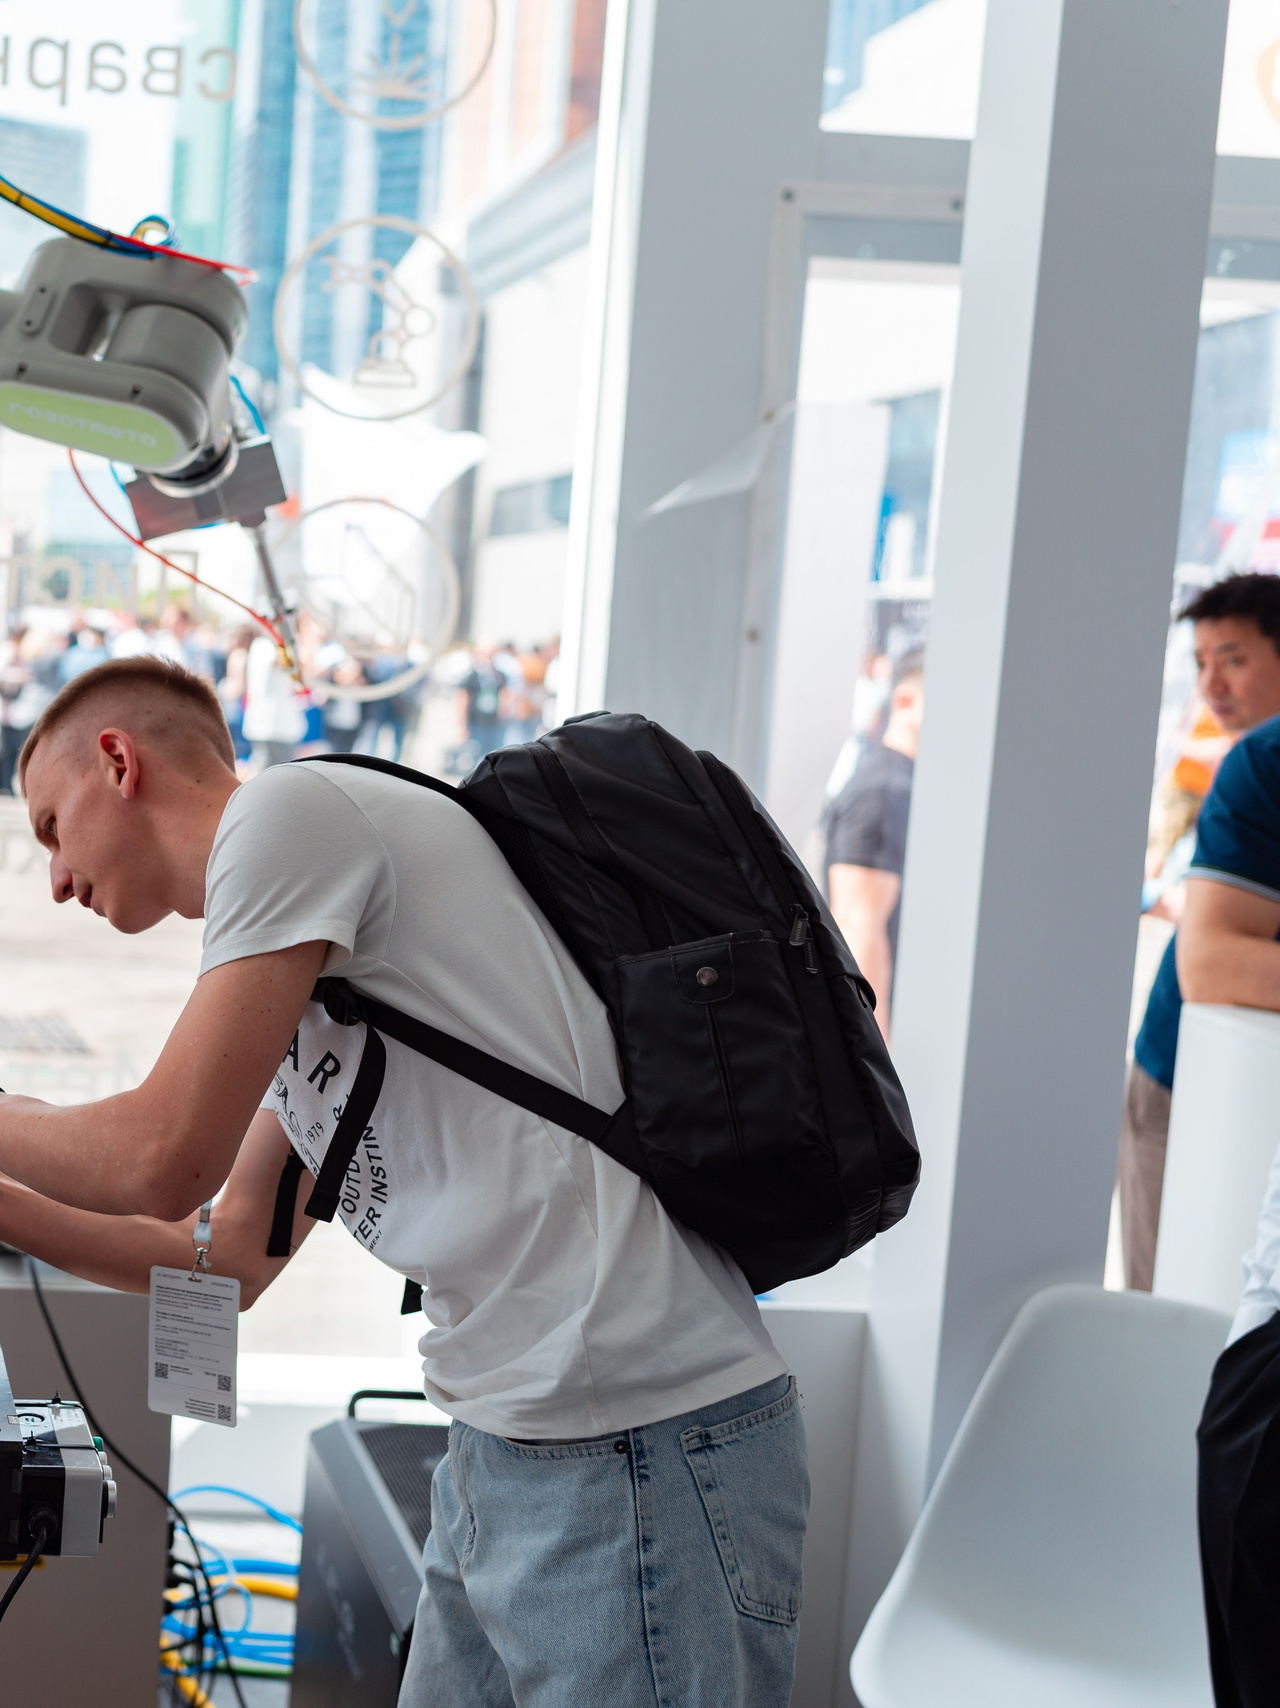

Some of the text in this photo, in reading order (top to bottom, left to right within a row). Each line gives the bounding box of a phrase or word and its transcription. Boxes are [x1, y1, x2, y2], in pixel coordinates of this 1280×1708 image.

[283, 1029, 341, 1094] AR
[305, 1121, 324, 1144] 1979
[353, 1126, 388, 1240] TER INSTIN
[369, 1230, 383, 1251] MENT
